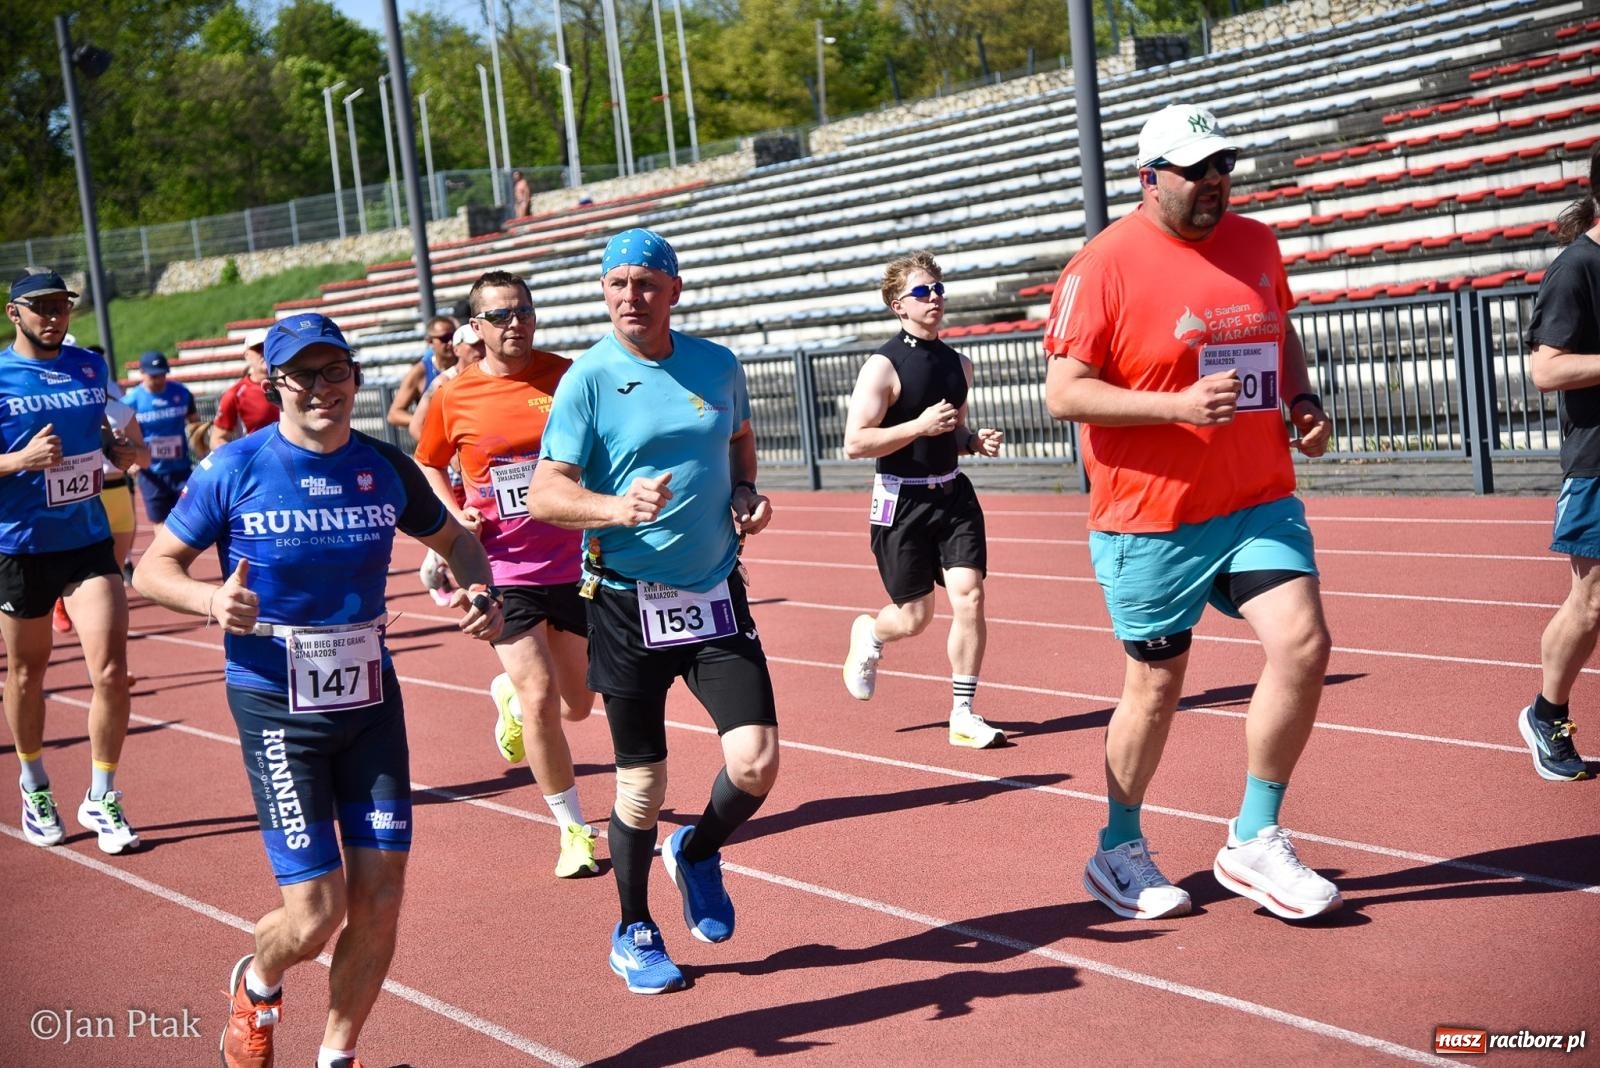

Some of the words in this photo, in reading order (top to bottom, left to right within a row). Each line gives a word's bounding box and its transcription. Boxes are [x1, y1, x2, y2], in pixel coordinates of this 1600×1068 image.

[1209, 316, 1242, 331] CAPE
[1246, 311, 1278, 324] TOWN
[1211, 323, 1281, 343] MARATHON
[7, 387, 106, 416] RUNNERS
[57, 474, 89, 497] 142
[240, 503, 396, 535] RUNNERS
[348, 532, 380, 543] TEAM
[656, 605, 704, 634] 153
[295, 640, 312, 650] XVIII
[313, 640, 331, 649] BIEG
[333, 639, 345, 647] BEZ
[295, 648, 337, 659] 3MAJA2026
[308, 665, 360, 698] 147
[262, 728, 311, 850] RUNNERS
[268, 802, 279, 828] TEAM
